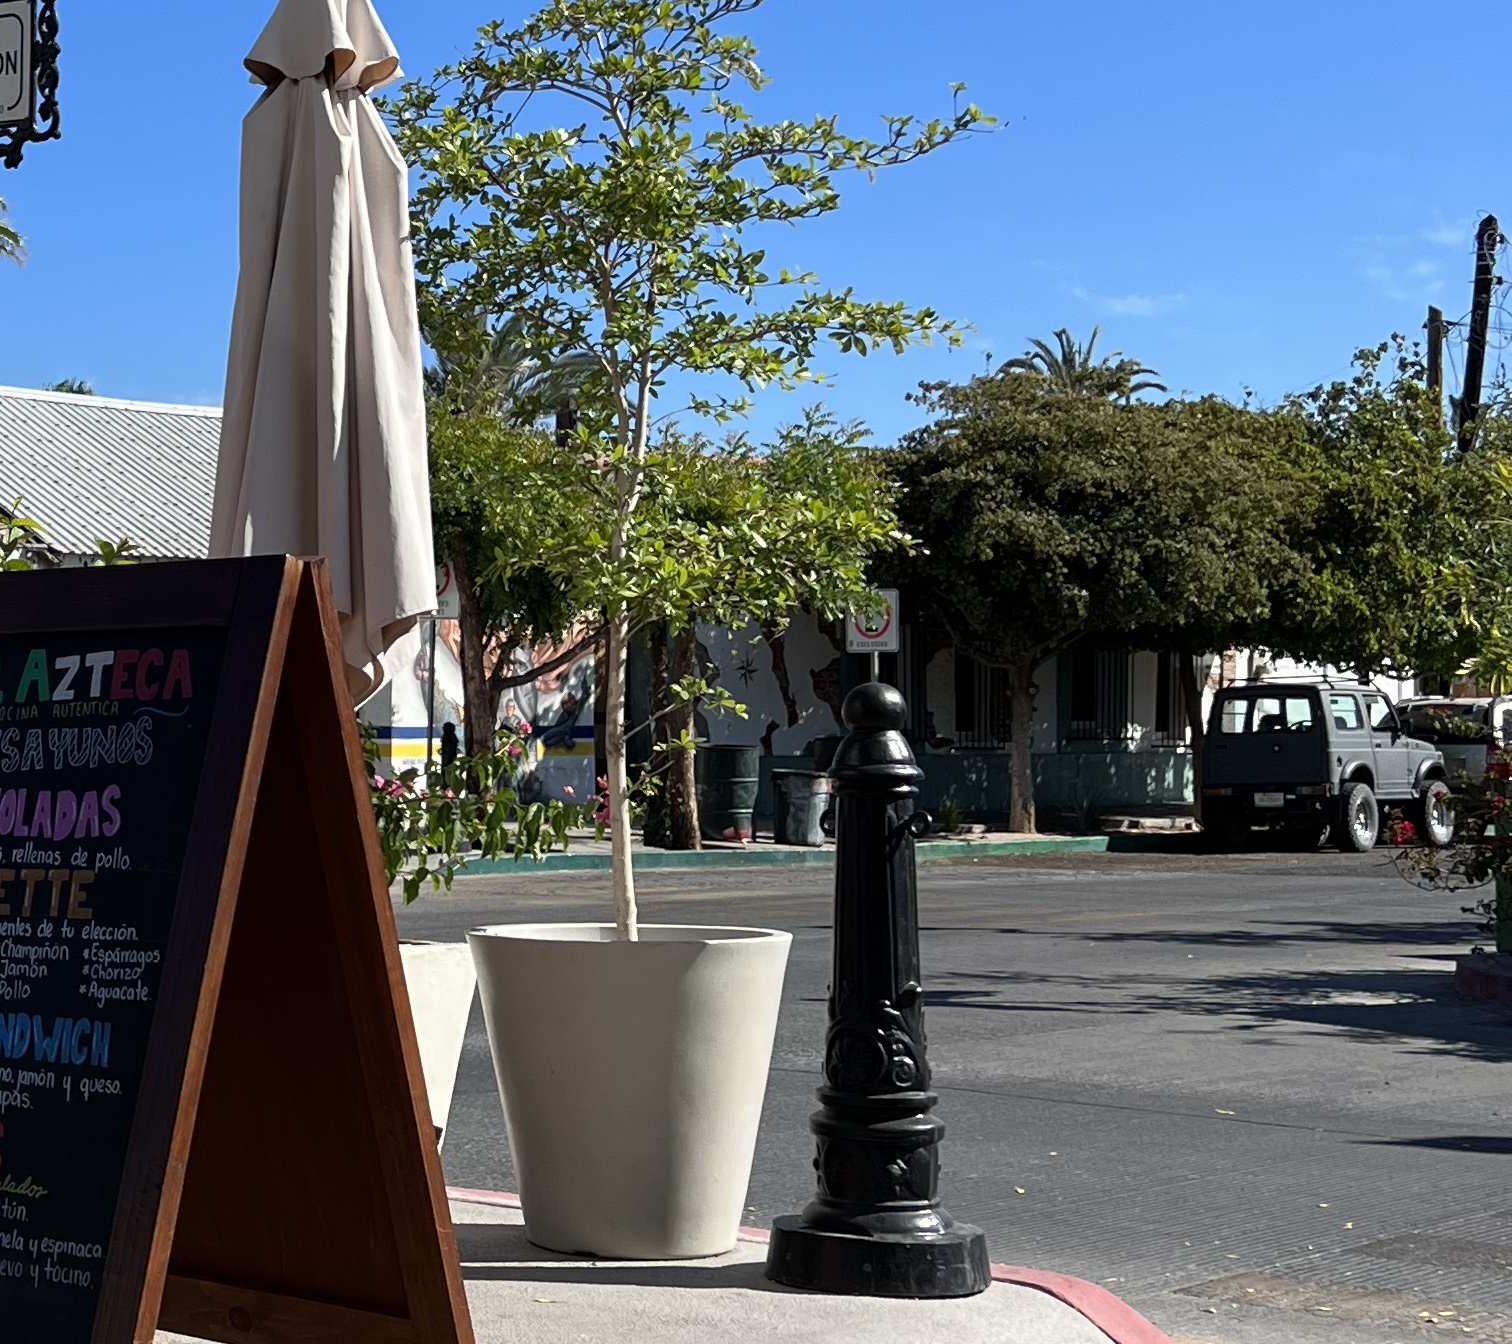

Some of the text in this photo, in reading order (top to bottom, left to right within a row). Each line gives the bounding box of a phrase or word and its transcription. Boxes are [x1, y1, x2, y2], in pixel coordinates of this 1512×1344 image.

[14, 648, 193, 702] AZTECA
[52, 701, 120, 717] AUTENTICA
[11, 841, 62, 866] rellenas
[70, 846, 88, 868] de
[37, 918, 54, 938] de
[61, 919, 75, 938] tu
[0, 937, 70, 962] Champiñón
[90, 943, 161, 970] Espárragos
[0, 958, 48, 978] Jamón
[90, 963, 142, 980] Chorizo
[16, 1067, 55, 1091] jamón
[63, 1075, 71, 1103] y
[28, 1239, 38, 1259] y
[29, 1264, 39, 1288] y
